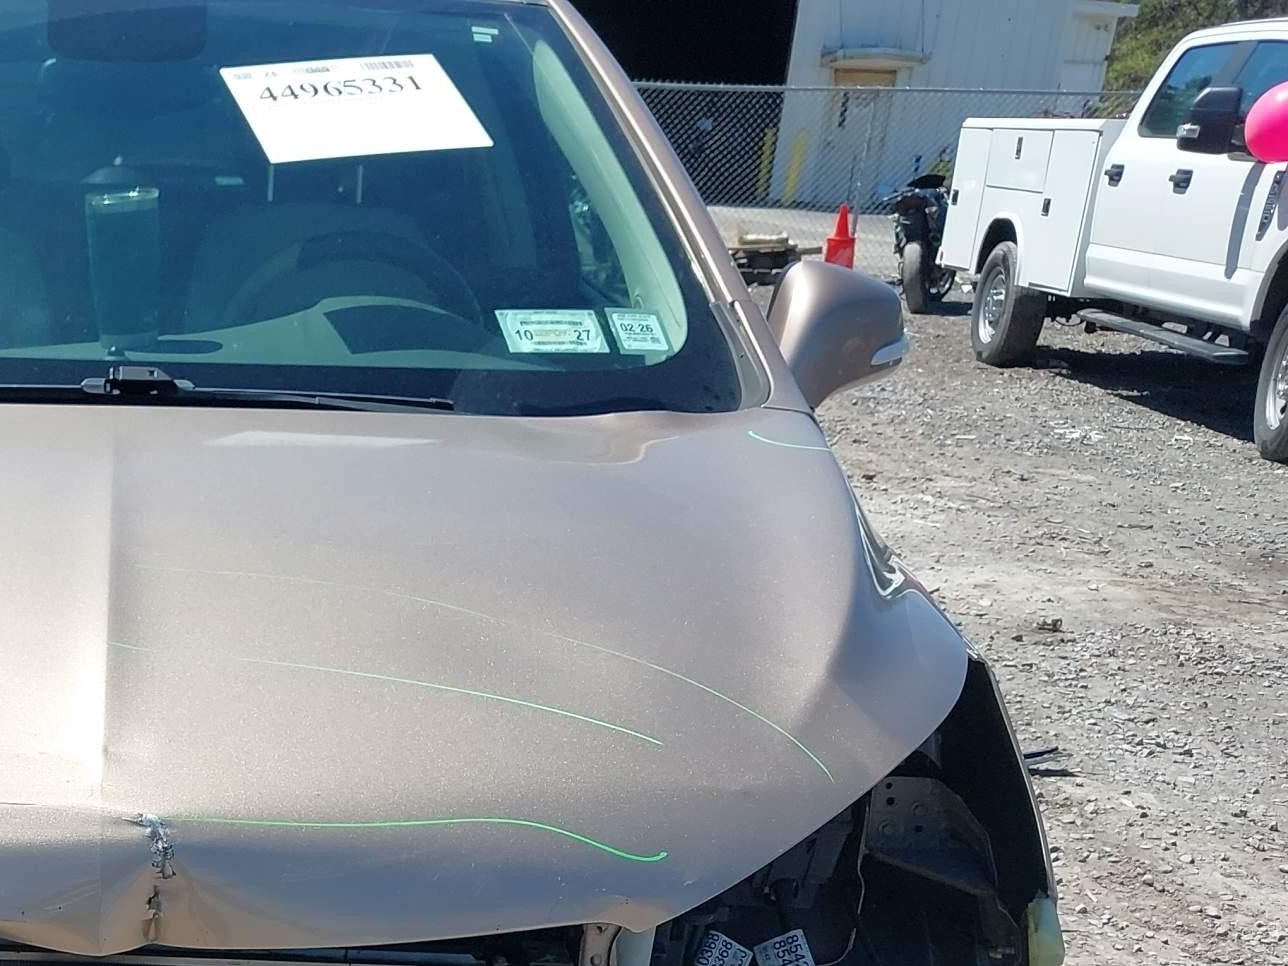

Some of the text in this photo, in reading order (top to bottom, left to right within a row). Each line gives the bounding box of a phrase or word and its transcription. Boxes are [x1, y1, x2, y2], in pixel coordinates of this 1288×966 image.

[259, 76, 422, 102] 44965331
[515, 329, 534, 341] 10
[573, 329, 591, 341] 27
[696, 933, 720, 966] 0368
